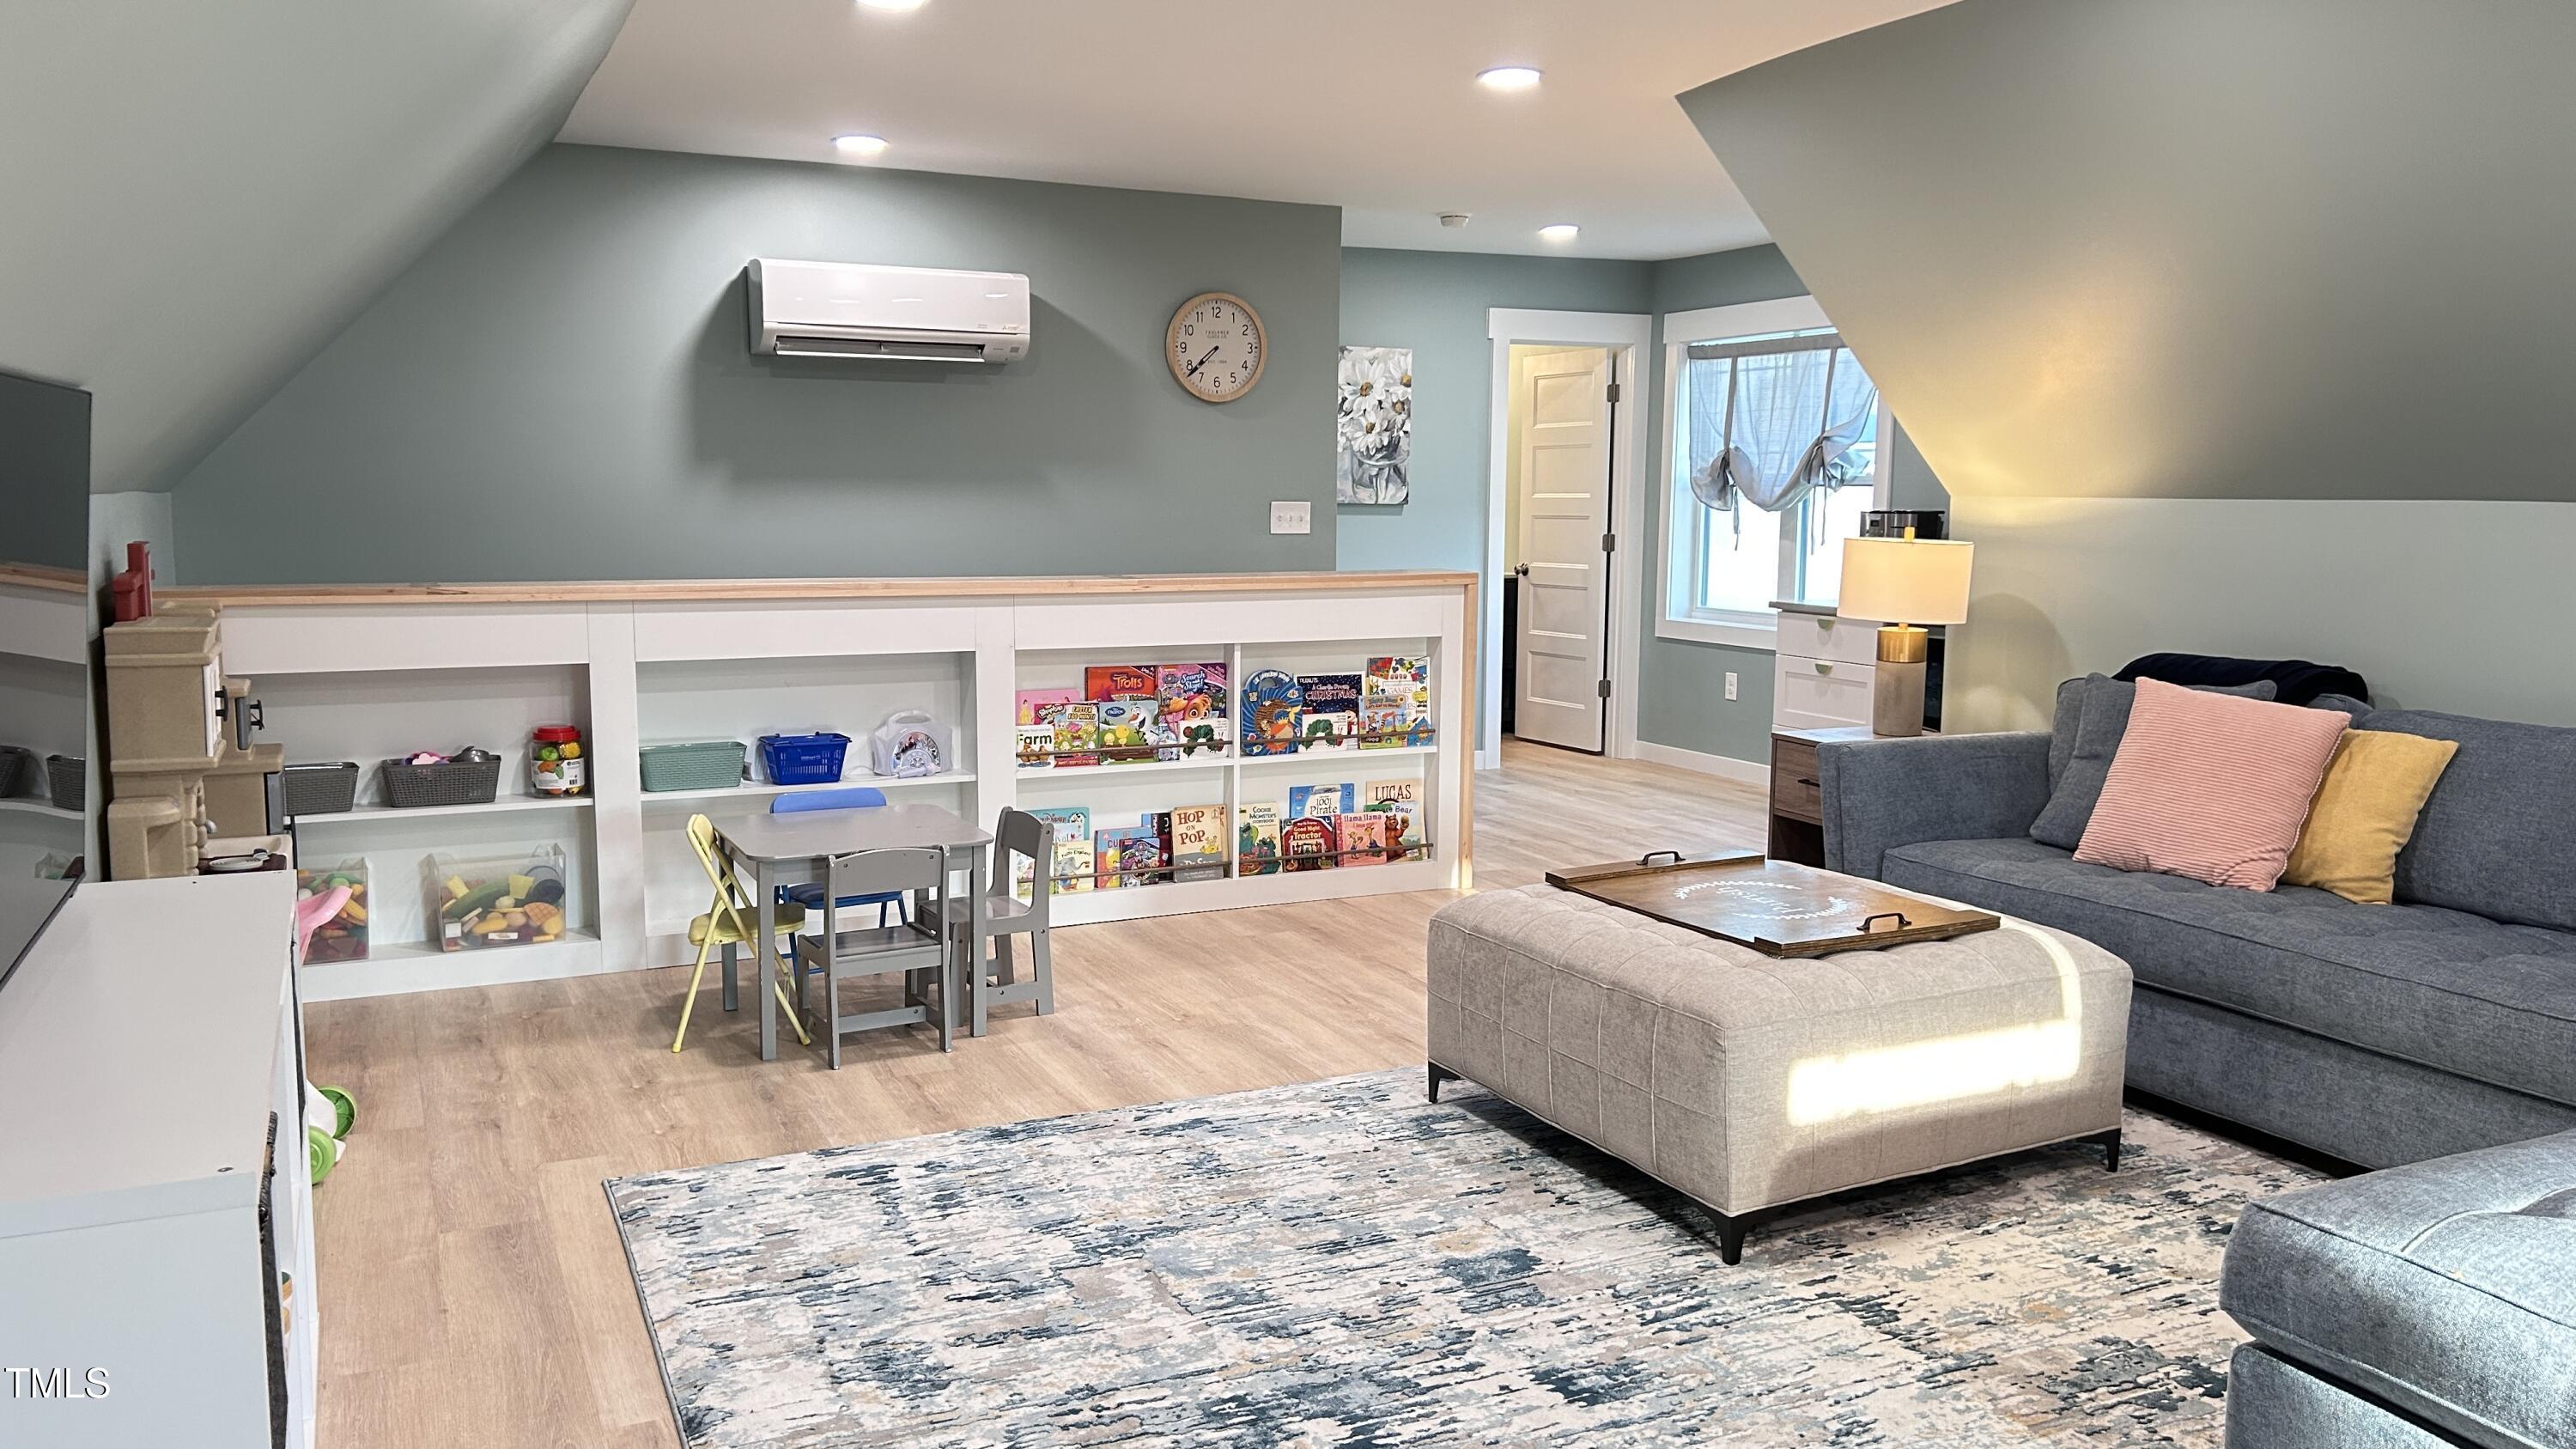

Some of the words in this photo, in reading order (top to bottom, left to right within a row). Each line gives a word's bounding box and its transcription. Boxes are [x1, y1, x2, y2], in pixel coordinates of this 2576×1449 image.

[1196, 311, 1204, 323] 11
[1212, 306, 1222, 319] 12
[1231, 313, 1236, 323] 1
[1184, 324, 1194, 336] 10
[1242, 324, 1249, 336] 2
[1180, 342, 1187, 353] 9
[1247, 343, 1254, 354] 3
[1186, 360, 1194, 371] 8
[1242, 360, 1249, 371] 4
[1199, 372, 1205, 383] 7
[1213, 376, 1221, 388] 6
[1230, 372, 1236, 383] 5
[1113, 675, 1143, 690] Trolls
[1181, 671, 1206, 683] Search
[1184, 679, 1204, 691] Skye!
[1305, 690, 1357, 701] CHRISTMAS
[1019, 734, 1053, 746] Farm
[1376, 784, 1412, 801] LUCAS
[1310, 806, 1338, 815] Pirate
[1177, 810, 1205, 825] HOP
[1178, 830, 1206, 845] POP
